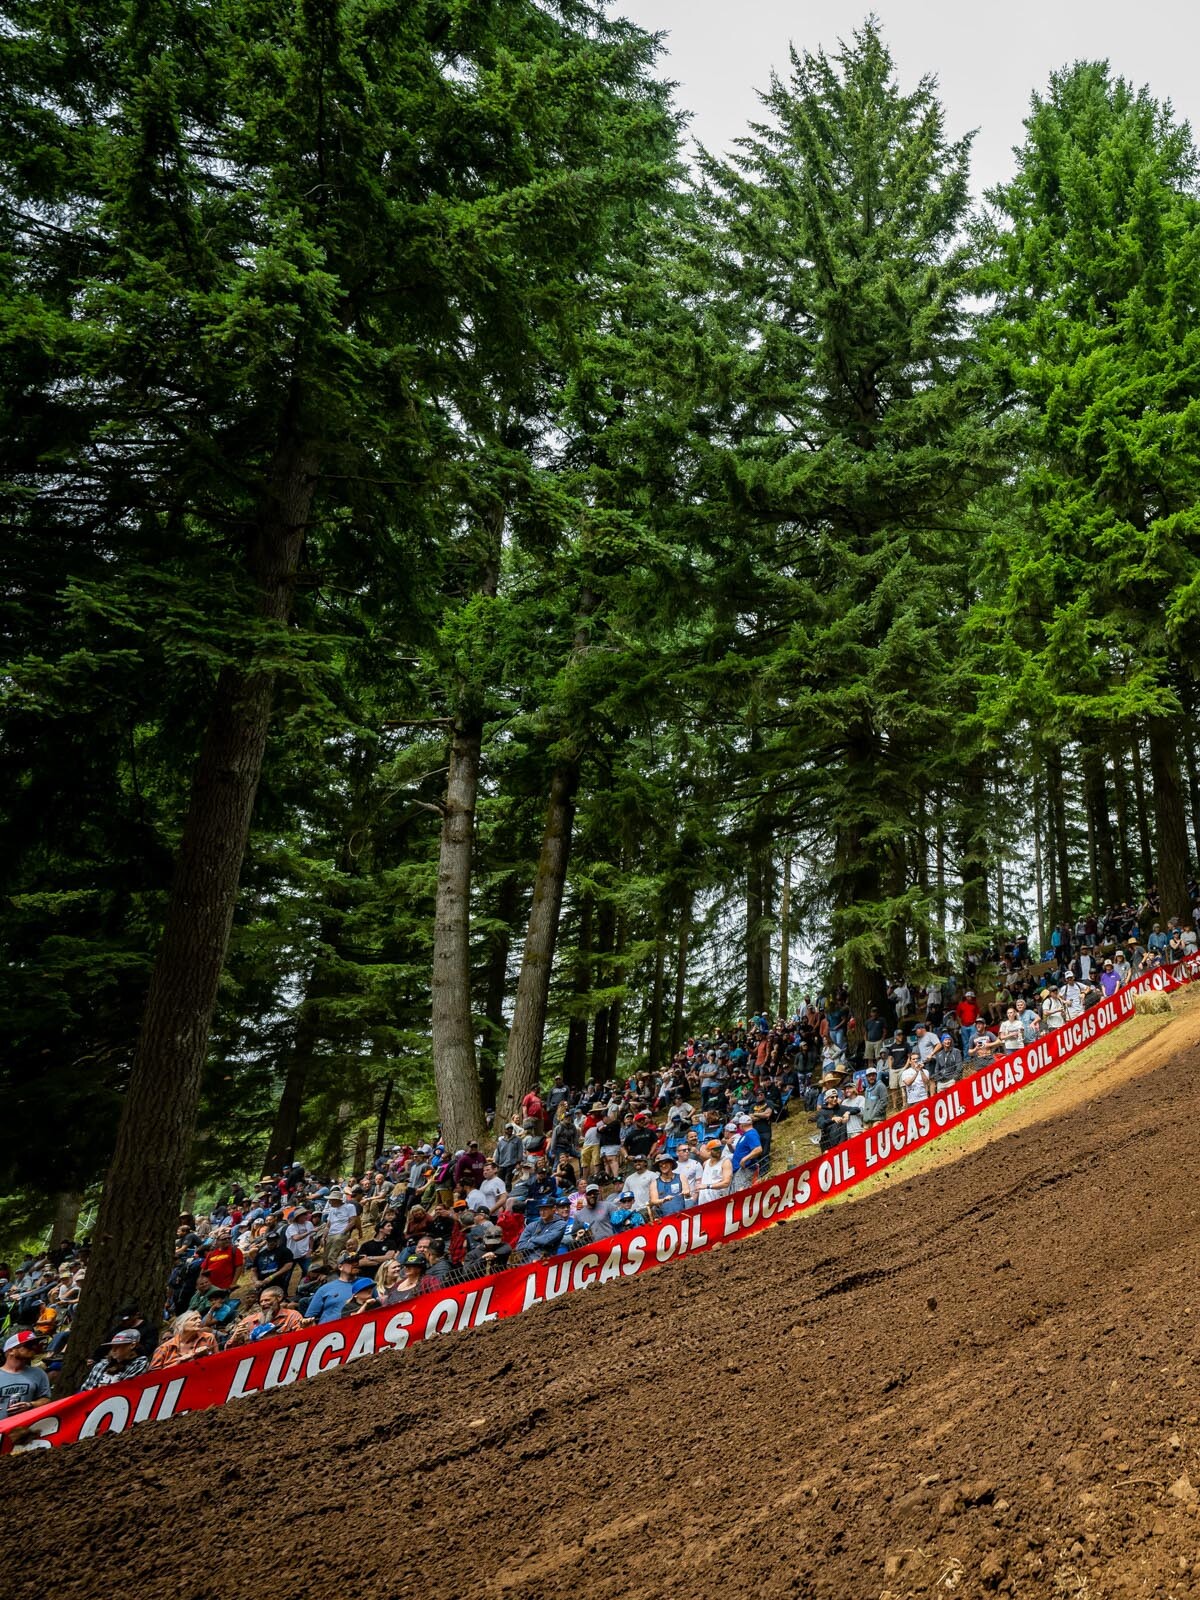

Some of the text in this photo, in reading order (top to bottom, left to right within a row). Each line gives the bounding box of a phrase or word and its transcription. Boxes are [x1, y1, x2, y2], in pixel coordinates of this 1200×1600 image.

[1057, 1001, 1118, 1057] LUCAS OIL
[972, 1042, 1053, 1107] LUCAS OIL
[865, 1091, 966, 1167] LUCAS OIL
[723, 1150, 855, 1236] LUCAS OIL
[522, 1214, 708, 1312] LUCAS OIL
[226, 1286, 498, 1404] LUCAS OIL
[79, 1376, 191, 1440] OIL
